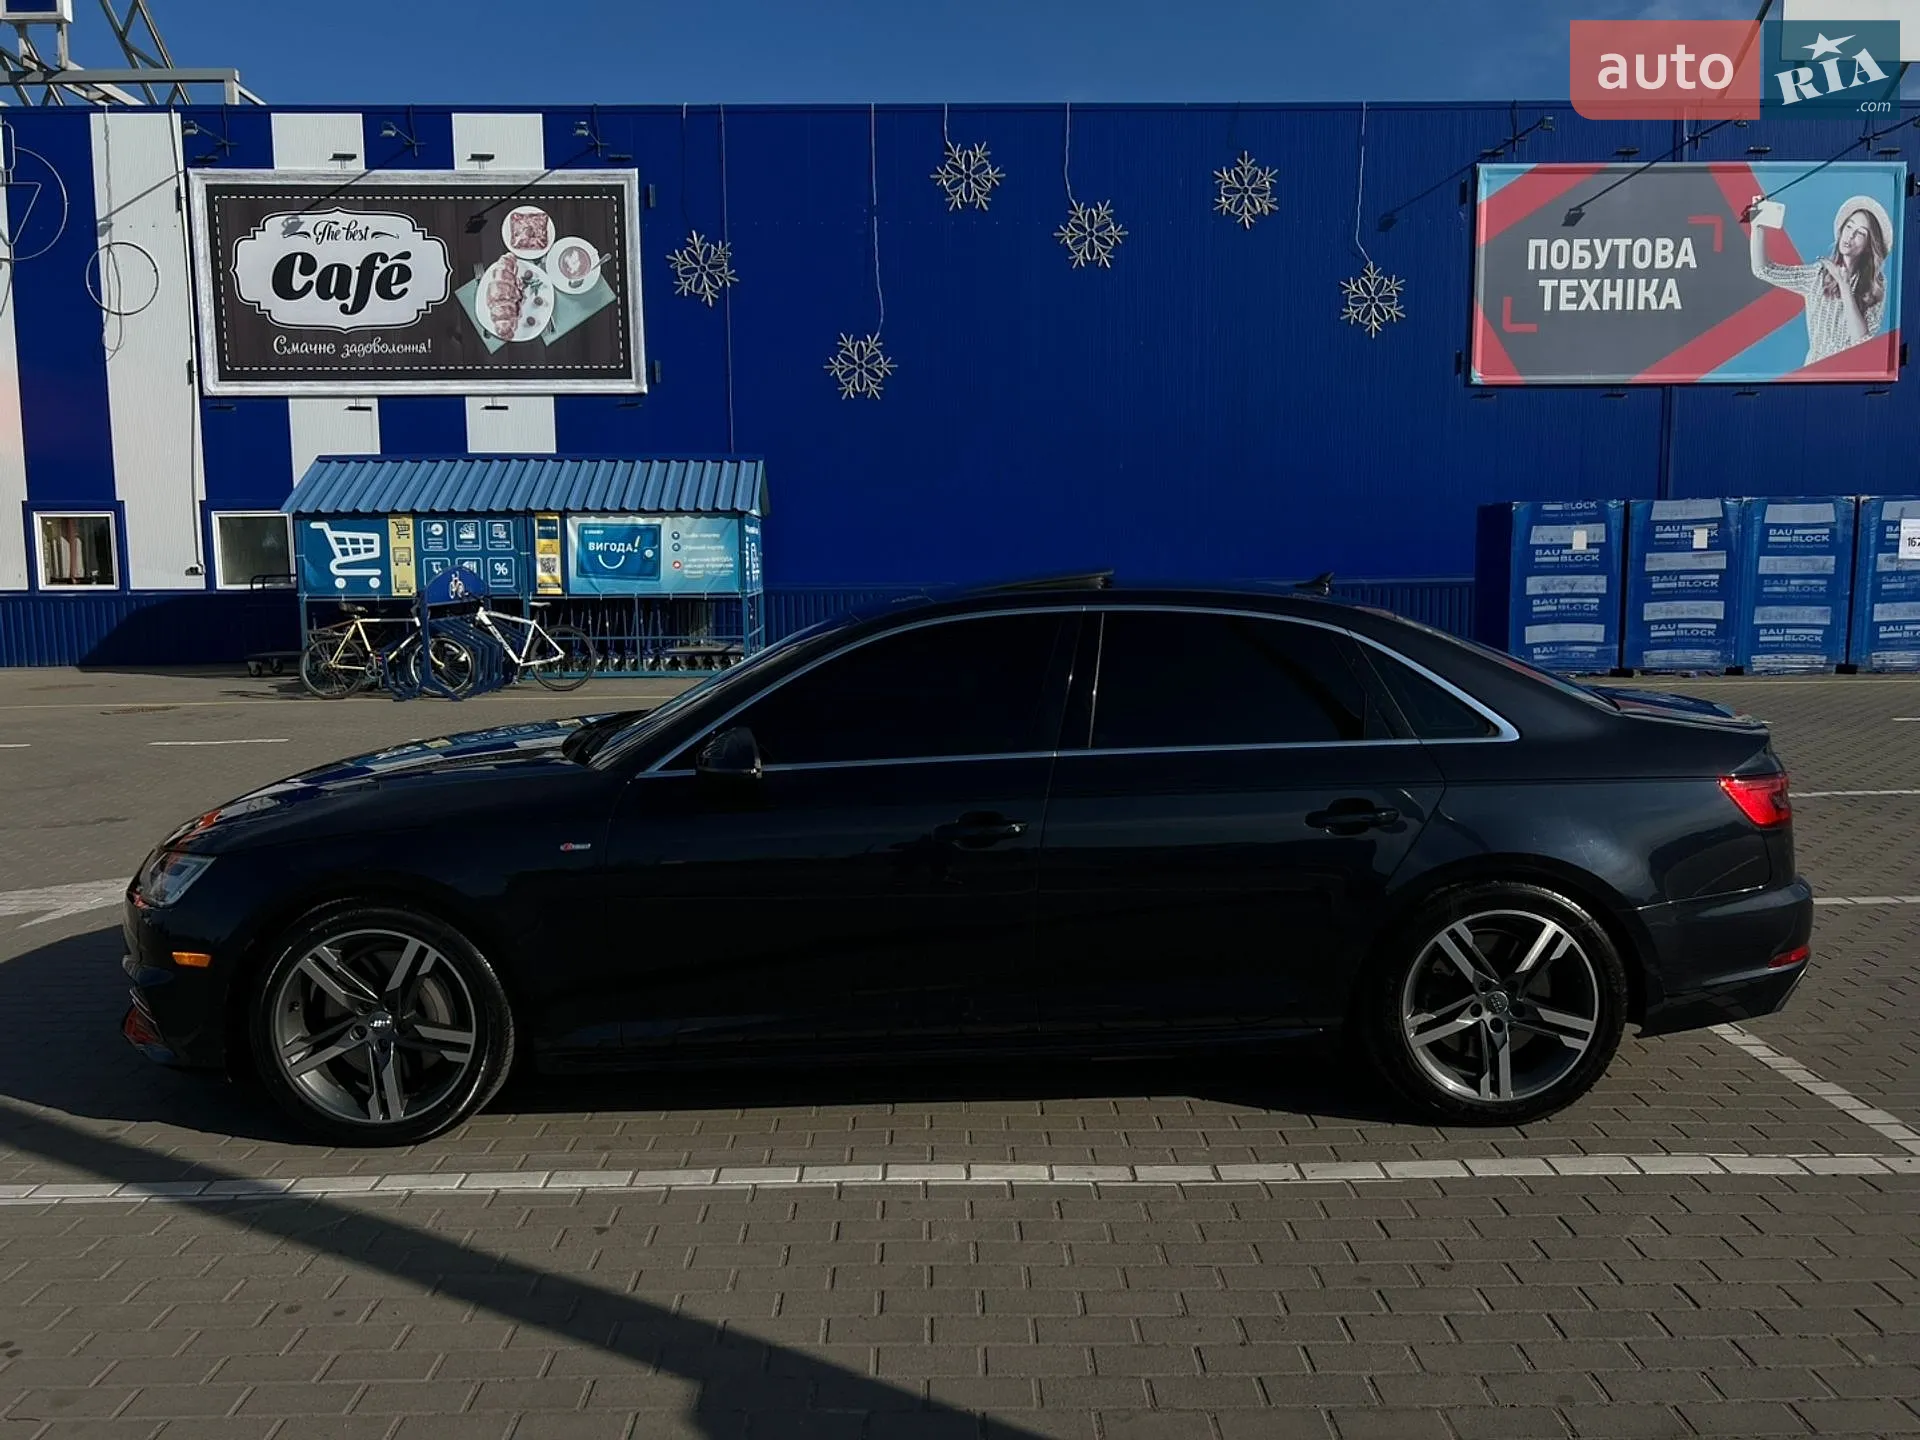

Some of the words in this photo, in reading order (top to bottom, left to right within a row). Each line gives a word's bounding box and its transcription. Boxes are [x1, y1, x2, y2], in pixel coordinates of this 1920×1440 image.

[313, 219, 342, 245] The
[342, 219, 370, 242] best
[1527, 237, 1698, 270] ПОБУТОВА
[271, 250, 412, 315] Café
[1538, 278, 1682, 311] ТЕХНІКА
[273, 334, 336, 355] Смачне
[340, 336, 432, 359] задоволення!
[1680, 529, 1719, 538] BLK
[1792, 534, 1830, 542] BLOCK
[588, 535, 641, 553] ВИГОДА!
[1560, 554, 1600, 562] BLOCK
[1678, 580, 1720, 588] BLOCK
[1676, 629, 1716, 637] BLOCK
[1784, 634, 1823, 642] BLOCK
